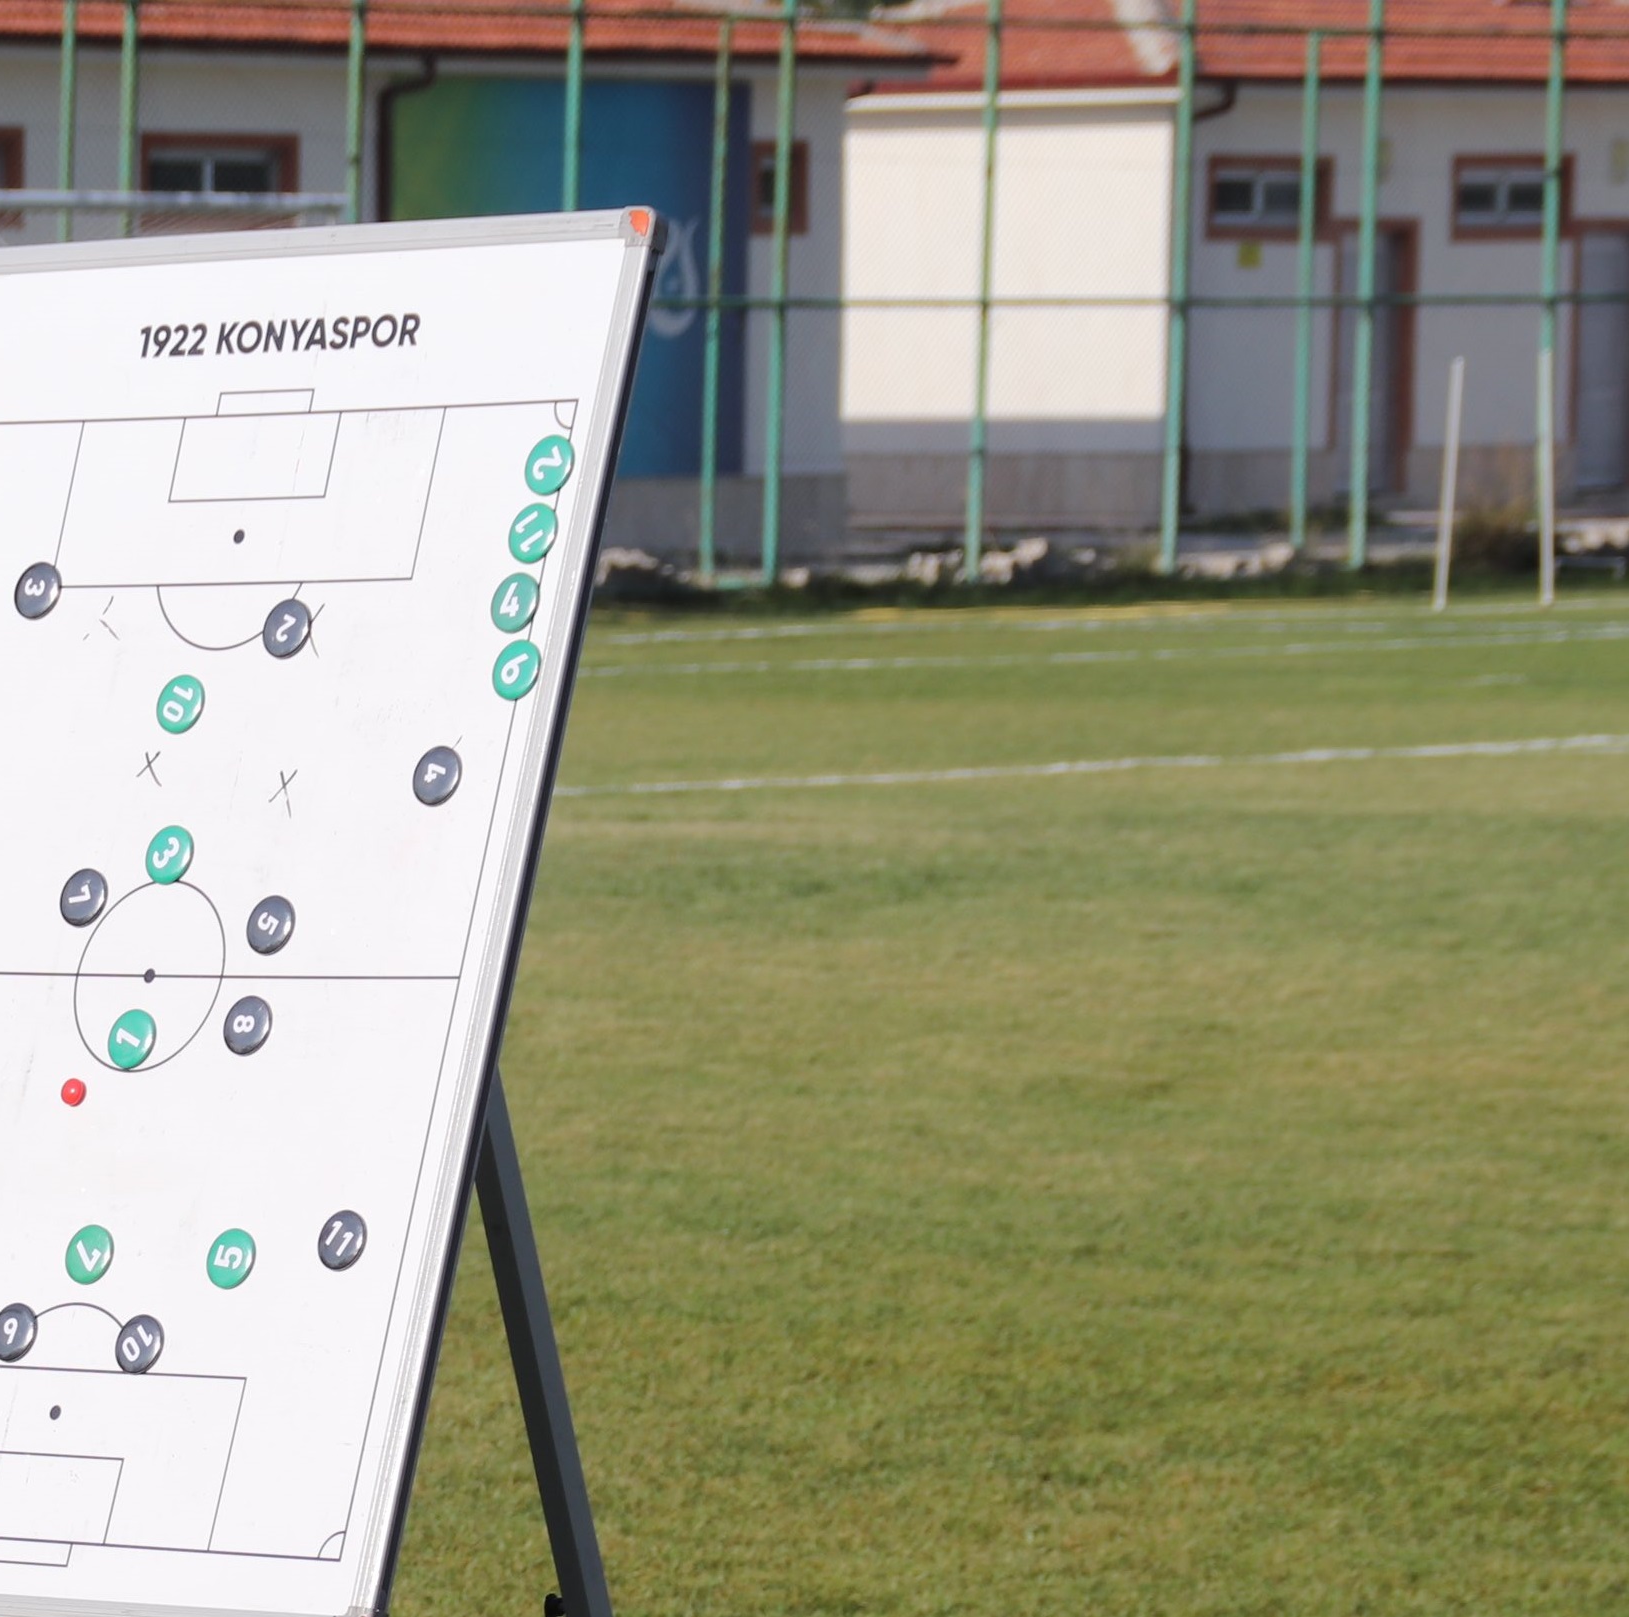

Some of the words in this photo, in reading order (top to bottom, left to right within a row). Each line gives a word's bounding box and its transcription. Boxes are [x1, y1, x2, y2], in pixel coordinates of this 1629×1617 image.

[140, 323, 208, 359] 1922
[215, 312, 422, 355] KONYASPOR
[533, 446, 563, 481] 2
[25, 578, 46, 597] 3
[499, 582, 520, 618] 4
[276, 614, 297, 642] 2
[162, 686, 196, 723] 10
[424, 763, 447, 784] 4
[152, 837, 181, 869] 3
[258, 912, 280, 935] 5
[116, 1028, 141, 1048] 1
[233, 1015, 256, 1033] 8
[326, 1221, 354, 1256] 11
[214, 1245, 243, 1268] 5
[122, 1325, 153, 1362] 10
